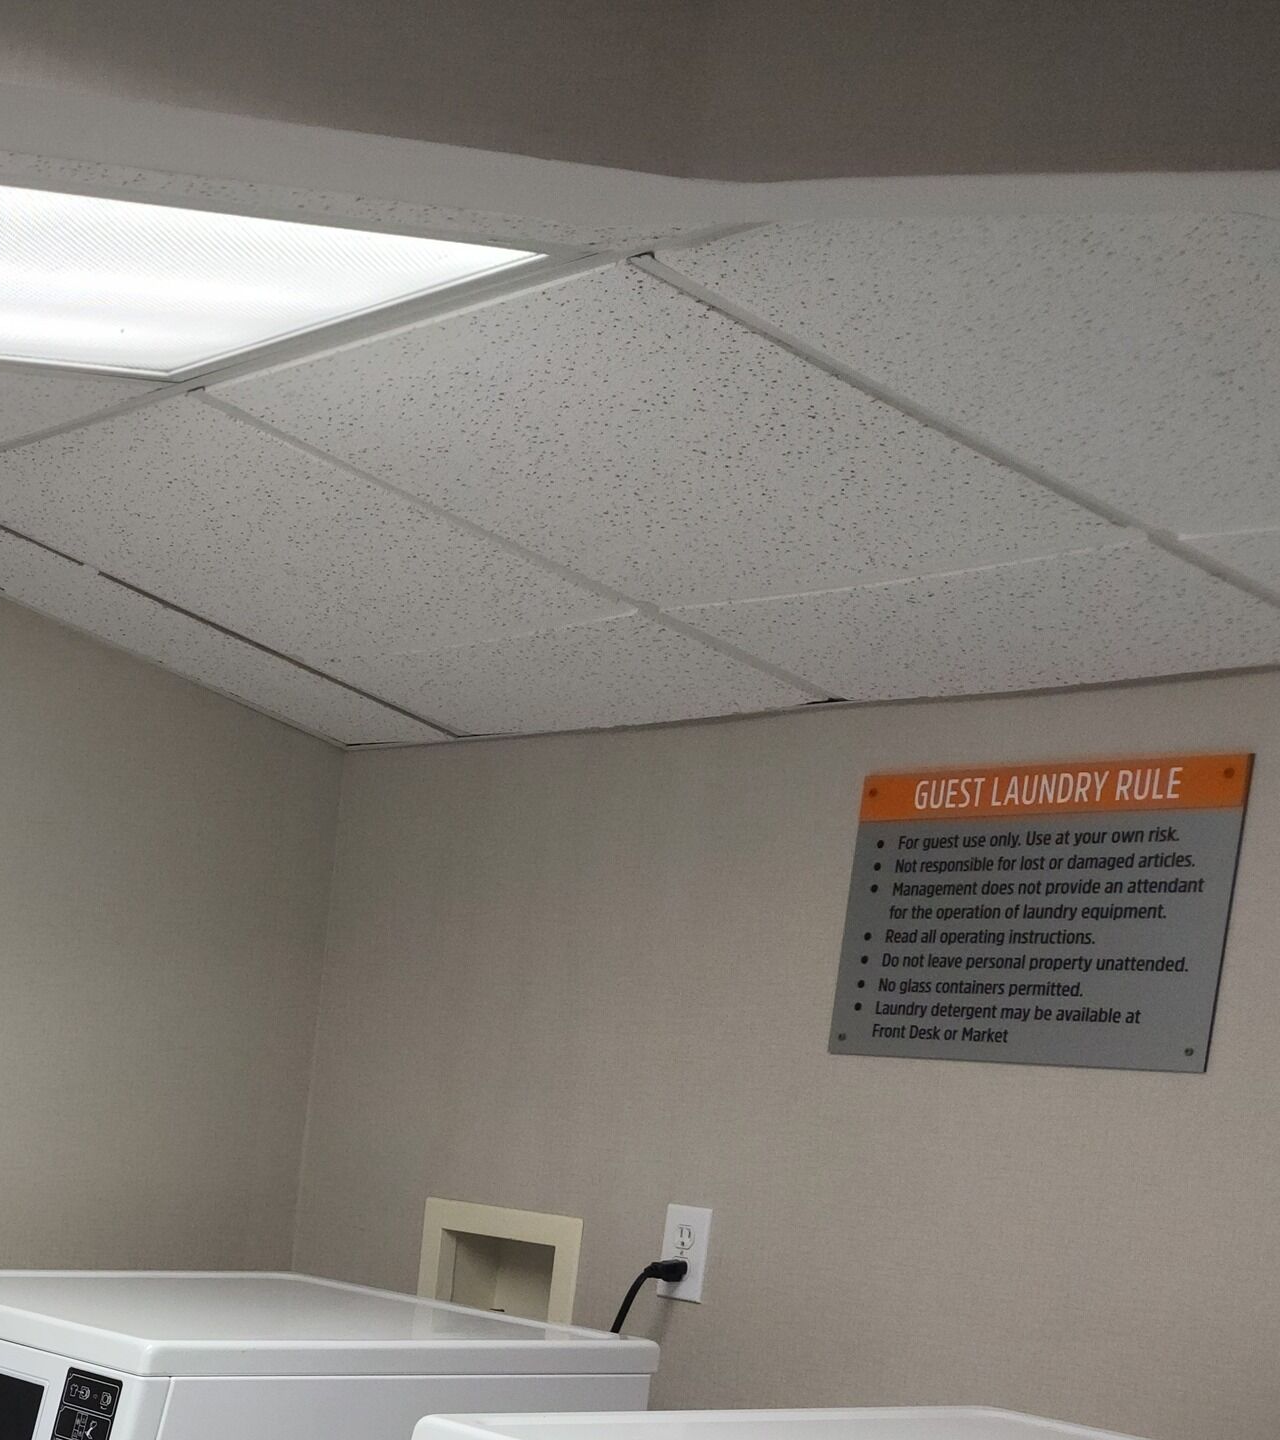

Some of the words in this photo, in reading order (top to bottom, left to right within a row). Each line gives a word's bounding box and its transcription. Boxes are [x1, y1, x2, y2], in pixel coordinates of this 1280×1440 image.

[915, 777, 986, 810] GUEST
[991, 770, 1110, 806] LAUNDRY
[1115, 767, 1183, 801] RULE
[898, 835, 919, 849] For
[923, 835, 959, 851] guest
[963, 835, 986, 848] use
[990, 832, 1021, 848] only.
[1026, 831, 1052, 846] Use
[1055, 830, 1069, 845] at
[1073, 831, 1107, 846] your
[1111, 830, 1144, 843] own
[1148, 826, 1180, 842] risk.
[895, 859, 917, 873] Not
[920, 857, 994, 874] responsible
[997, 856, 1017, 871] for
[1019, 856, 1045, 871] lost
[1049, 858, 1064, 870] or
[1067, 853, 1135, 871] damaged
[1138, 852, 1195, 868] articles.
[893, 881, 977, 898] Management
[981, 881, 1014, 895] does
[1018, 882, 1041, 895] not
[1045, 879, 1101, 896] provide
[1104, 881, 1123, 893] an
[1127, 878, 1205, 893] attendant
[890, 905, 908, 919] for
[911, 905, 932, 919] the
[936, 904, 1001, 921] operation
[1005, 904, 1021, 919] of
[1023, 904, 1077, 921] laundry
[1081, 904, 1166, 921] equipment.
[885, 929, 918, 943] Read
[921, 929, 937, 943] all
[940, 929, 1005, 946] operating
[1008, 929, 1095, 945] instructions.
[882, 953, 899, 967] Do
[902, 954, 925, 967] not
[928, 954, 962, 968] leave
[966, 955, 1026, 970] personal
[1029, 956, 1092, 973] property
[1096, 956, 1189, 972] unattended.
[878, 978, 895, 992] No
[899, 978, 931, 994] glass
[935, 979, 1005, 994] containers
[1008, 981, 1083, 997] permitted.
[876, 1001, 927, 1018] Laundry
[931, 1002, 997, 1020] detergent
[1000, 1007, 1031, 1022] may
[1034, 1006, 1052, 1020] be
[1056, 1007, 1121, 1023] available
[1125, 1009, 1141, 1024] at
[872, 1024, 906, 1039] Front
[909, 1025, 941, 1040] Desk
[944, 1029, 958, 1041] or
[961, 1027, 1008, 1043] Market
